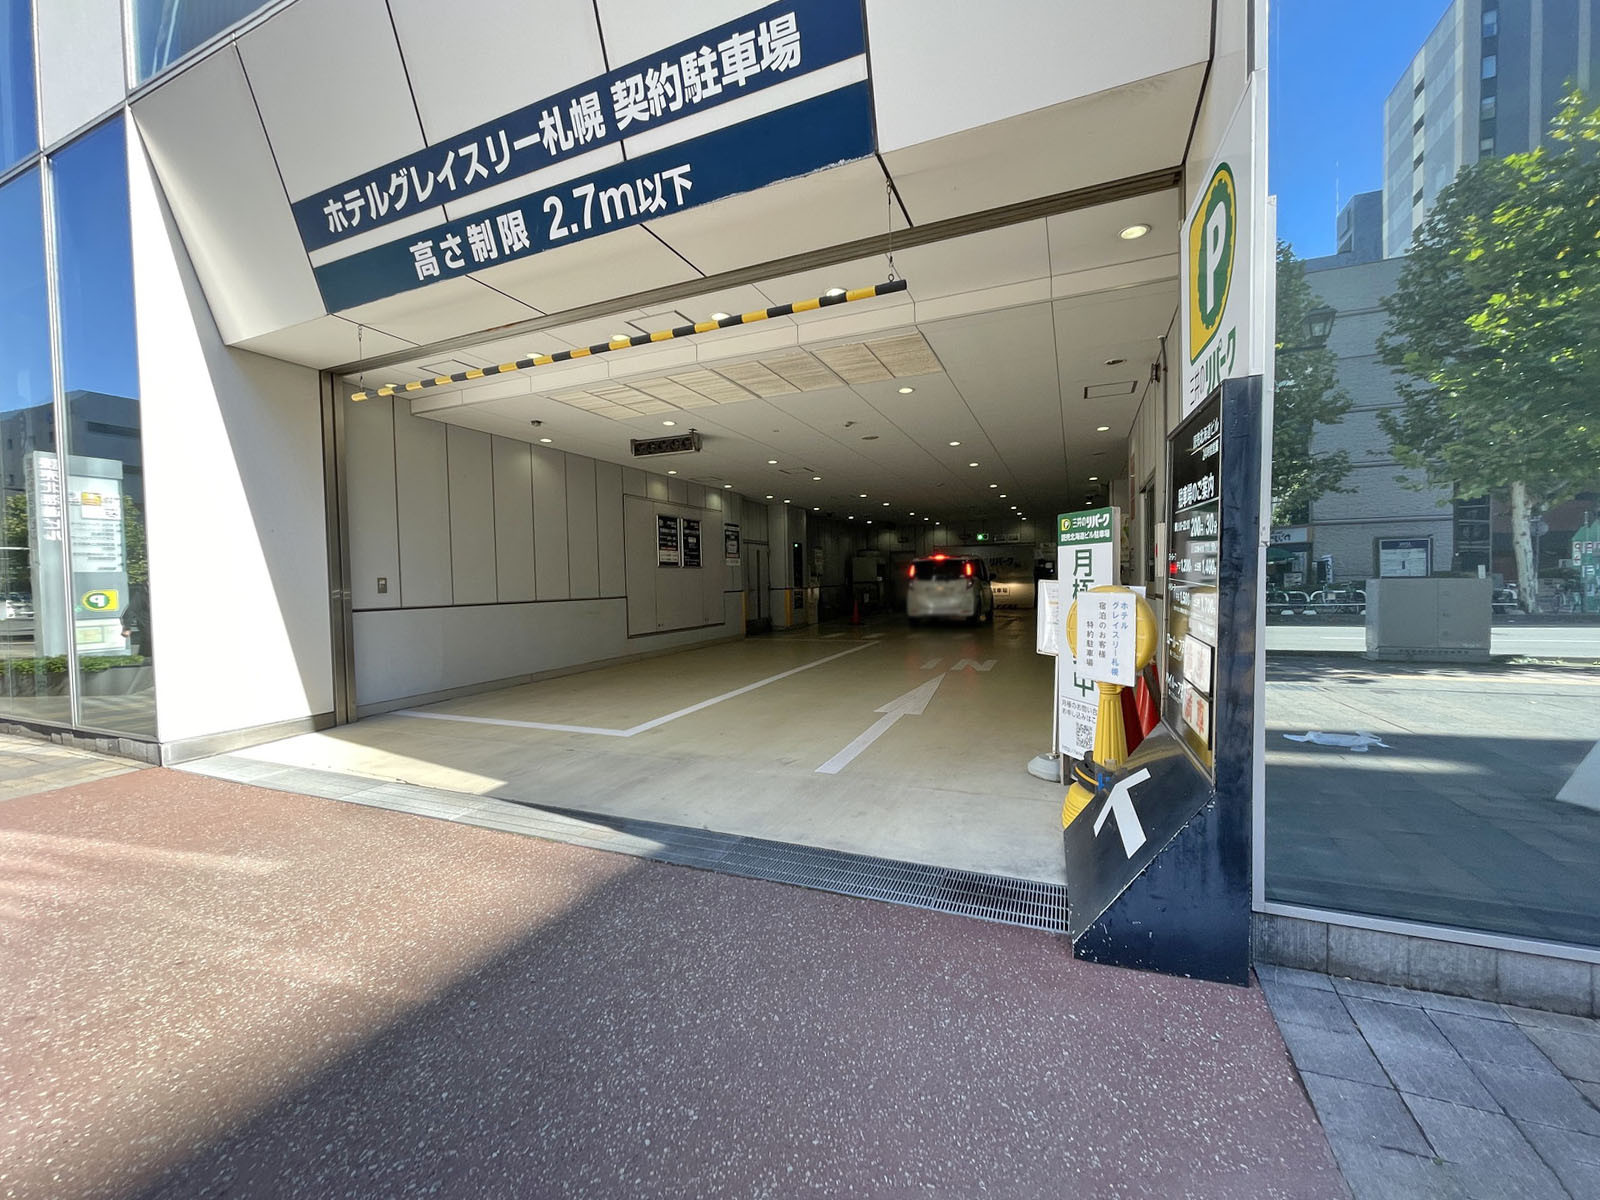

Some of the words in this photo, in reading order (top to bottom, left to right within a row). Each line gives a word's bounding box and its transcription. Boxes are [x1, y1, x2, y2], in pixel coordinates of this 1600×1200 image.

[323, 92, 606, 234] ホテルグレイスリー札幌
[610, 11, 801, 132] 契約駐車場
[409, 212, 531, 282] 高さ制限
[543, 163, 694, 241] 2.7m以下
[1205, 200, 1227, 315] P
[1190, 326, 1237, 406] 三井のリパーク
[1072, 513, 1110, 529] 三井のリパーク
[1178, 472, 1215, 508] 駐車場のご案内
[1072, 549, 1096, 697] 月極中
[1098, 601, 1107, 658] 宿泊のお客様
[1120, 602, 1129, 630] ホテル
